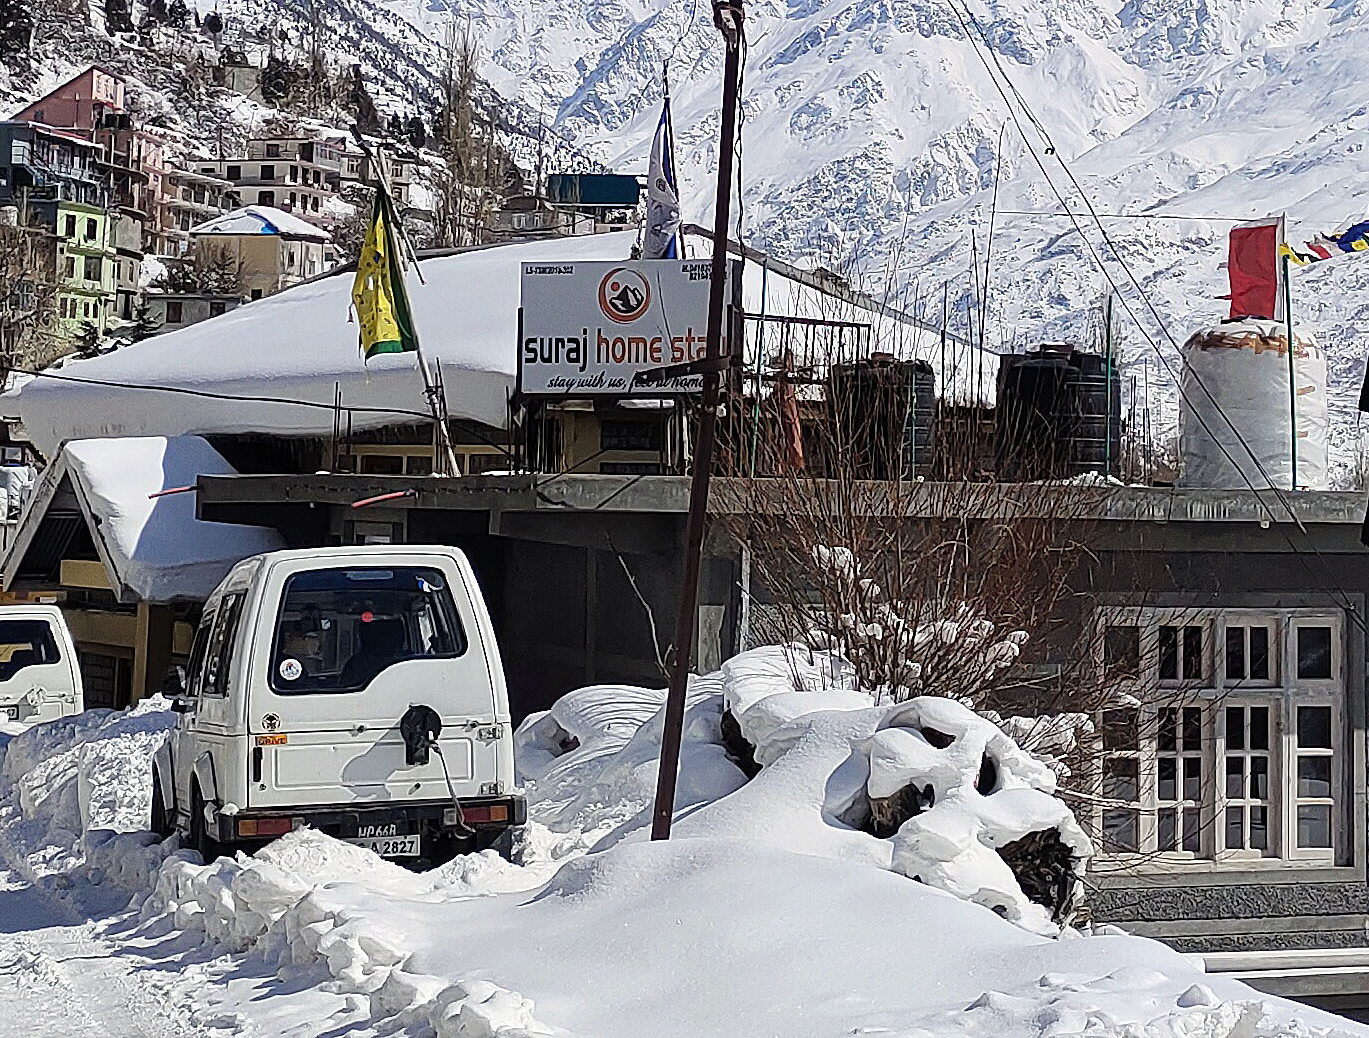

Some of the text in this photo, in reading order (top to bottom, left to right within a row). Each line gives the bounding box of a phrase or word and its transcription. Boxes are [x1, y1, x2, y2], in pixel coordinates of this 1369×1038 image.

[524, 328, 587, 373] suraj
[597, 328, 662, 364] home
[547, 375, 576, 393] stay
[576, 370, 607, 389] with
[383, 840, 415, 854] 2827
